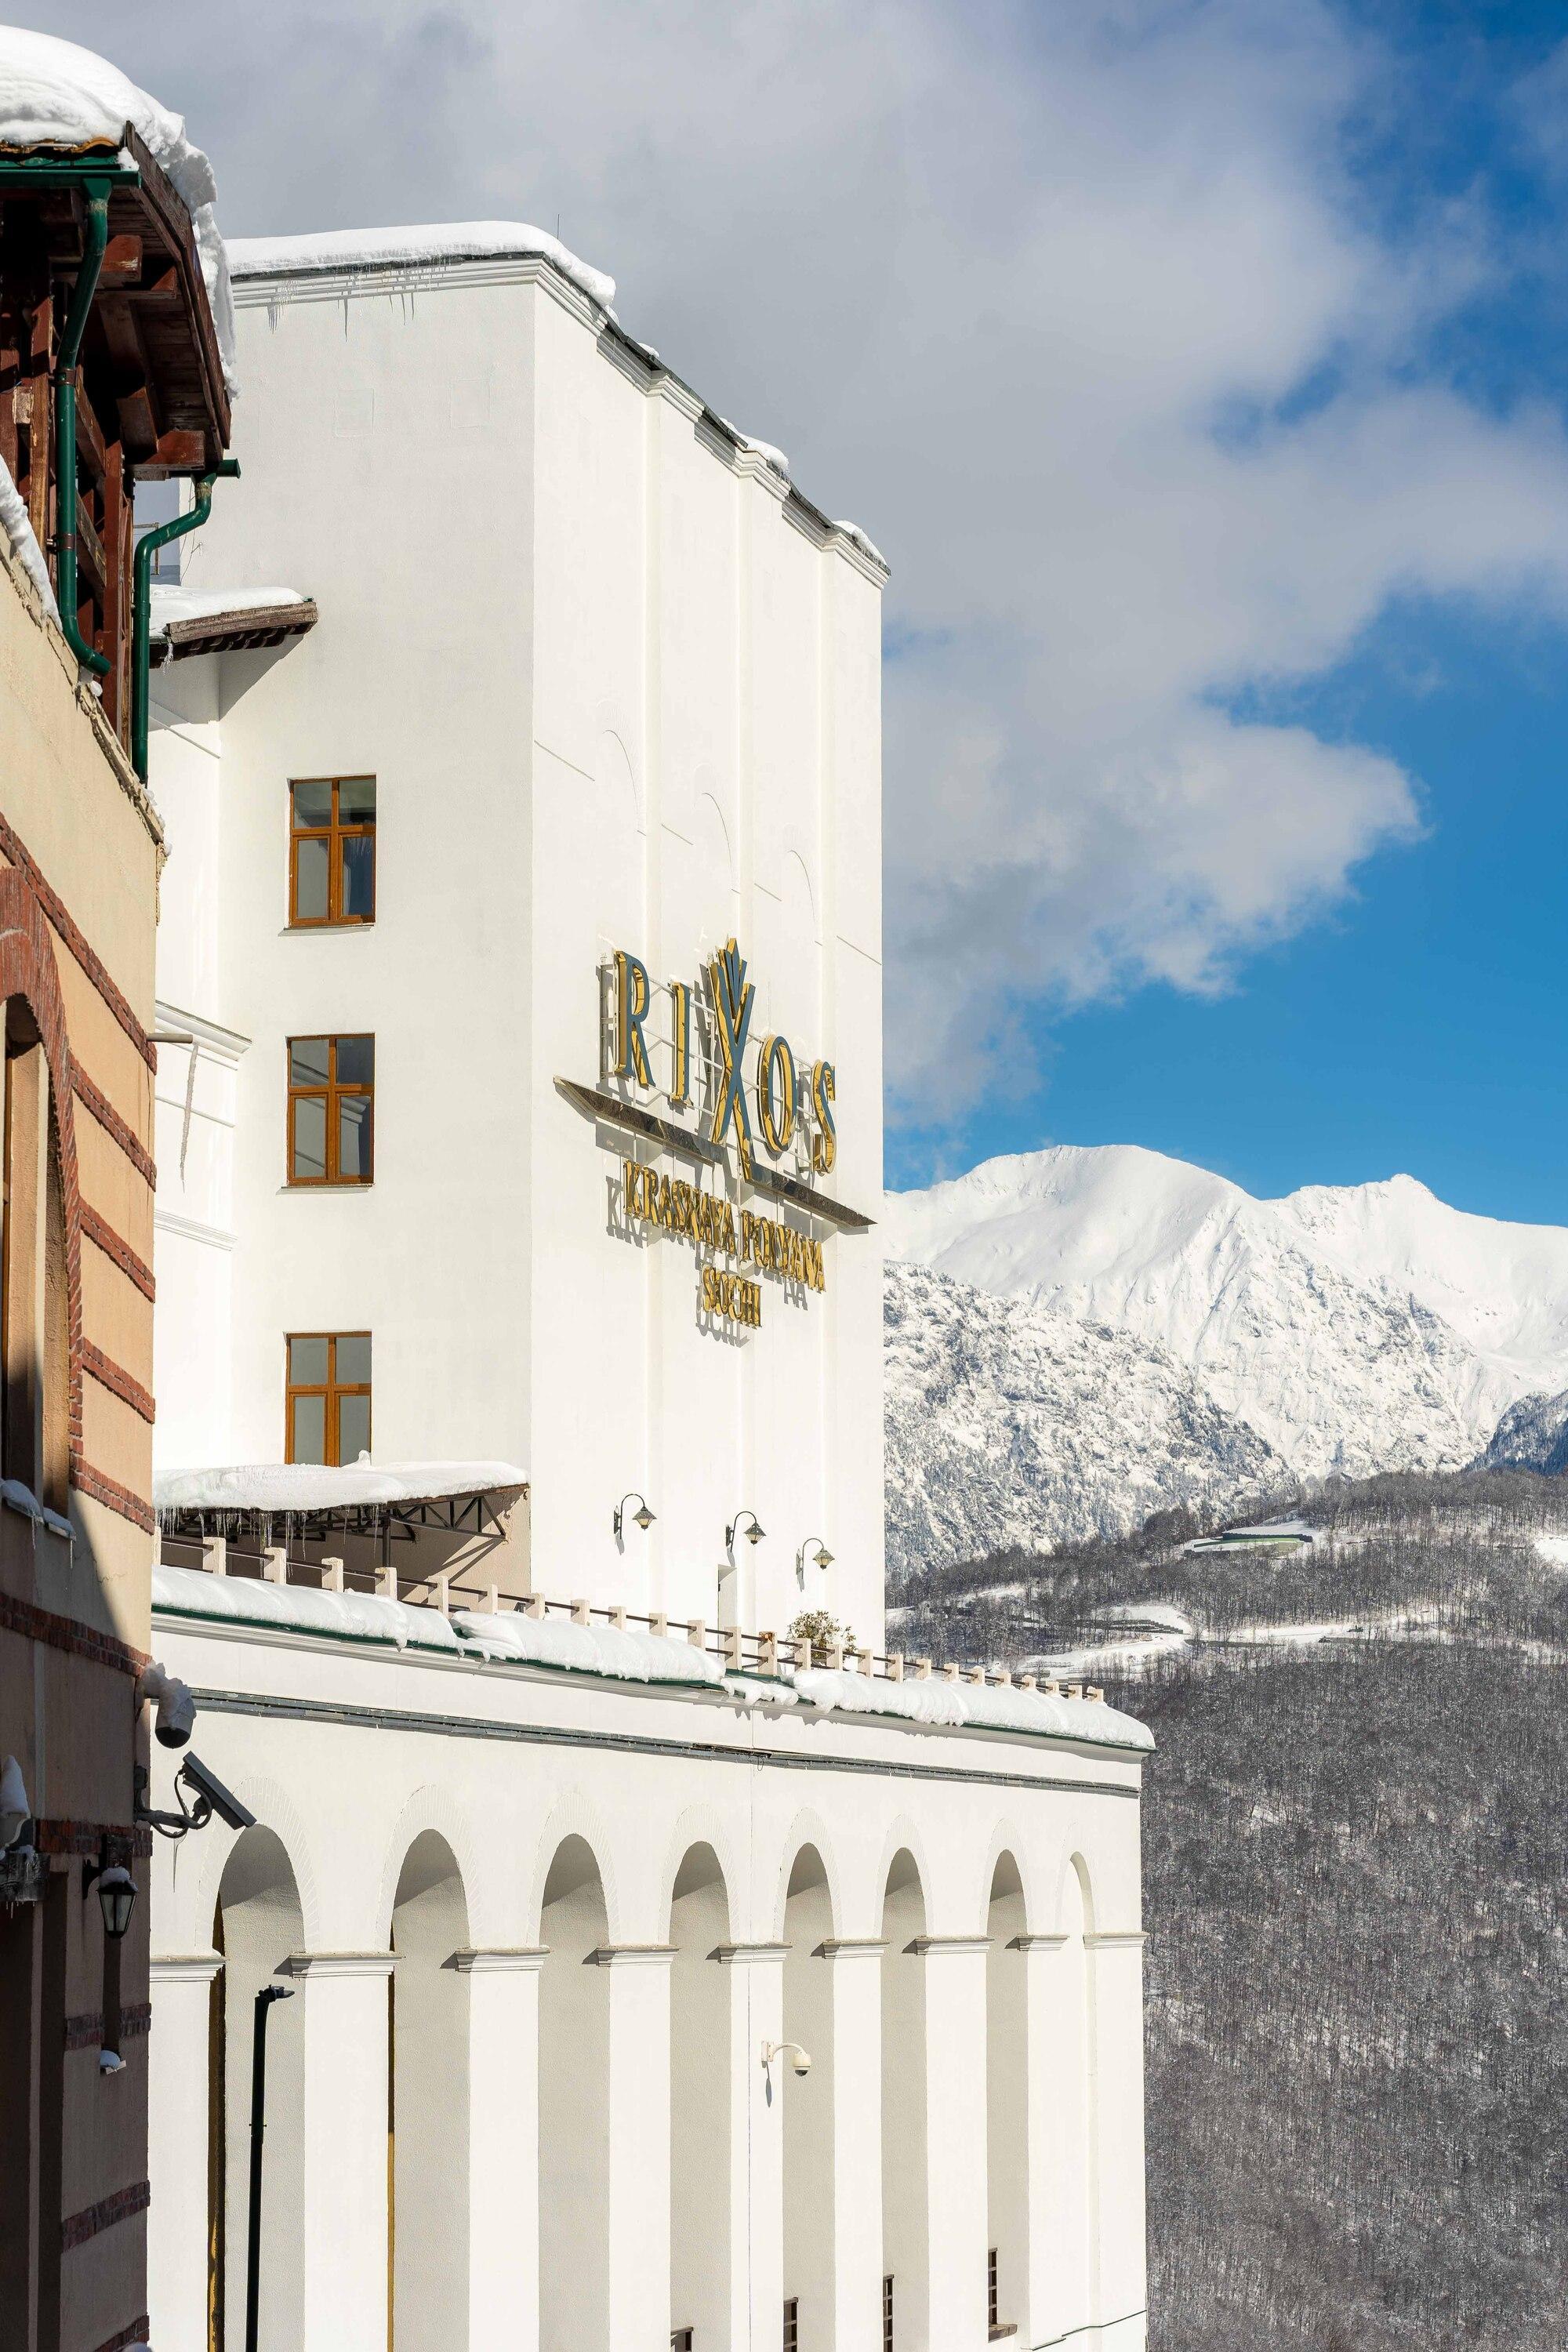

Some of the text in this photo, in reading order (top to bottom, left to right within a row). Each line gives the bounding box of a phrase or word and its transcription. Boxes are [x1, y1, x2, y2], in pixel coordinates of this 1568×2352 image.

[615, 938, 836, 1182] RIXOS
[623, 1161, 826, 1293] KRASNAYA POLYANA
[702, 1265, 762, 1329] SOCHI
